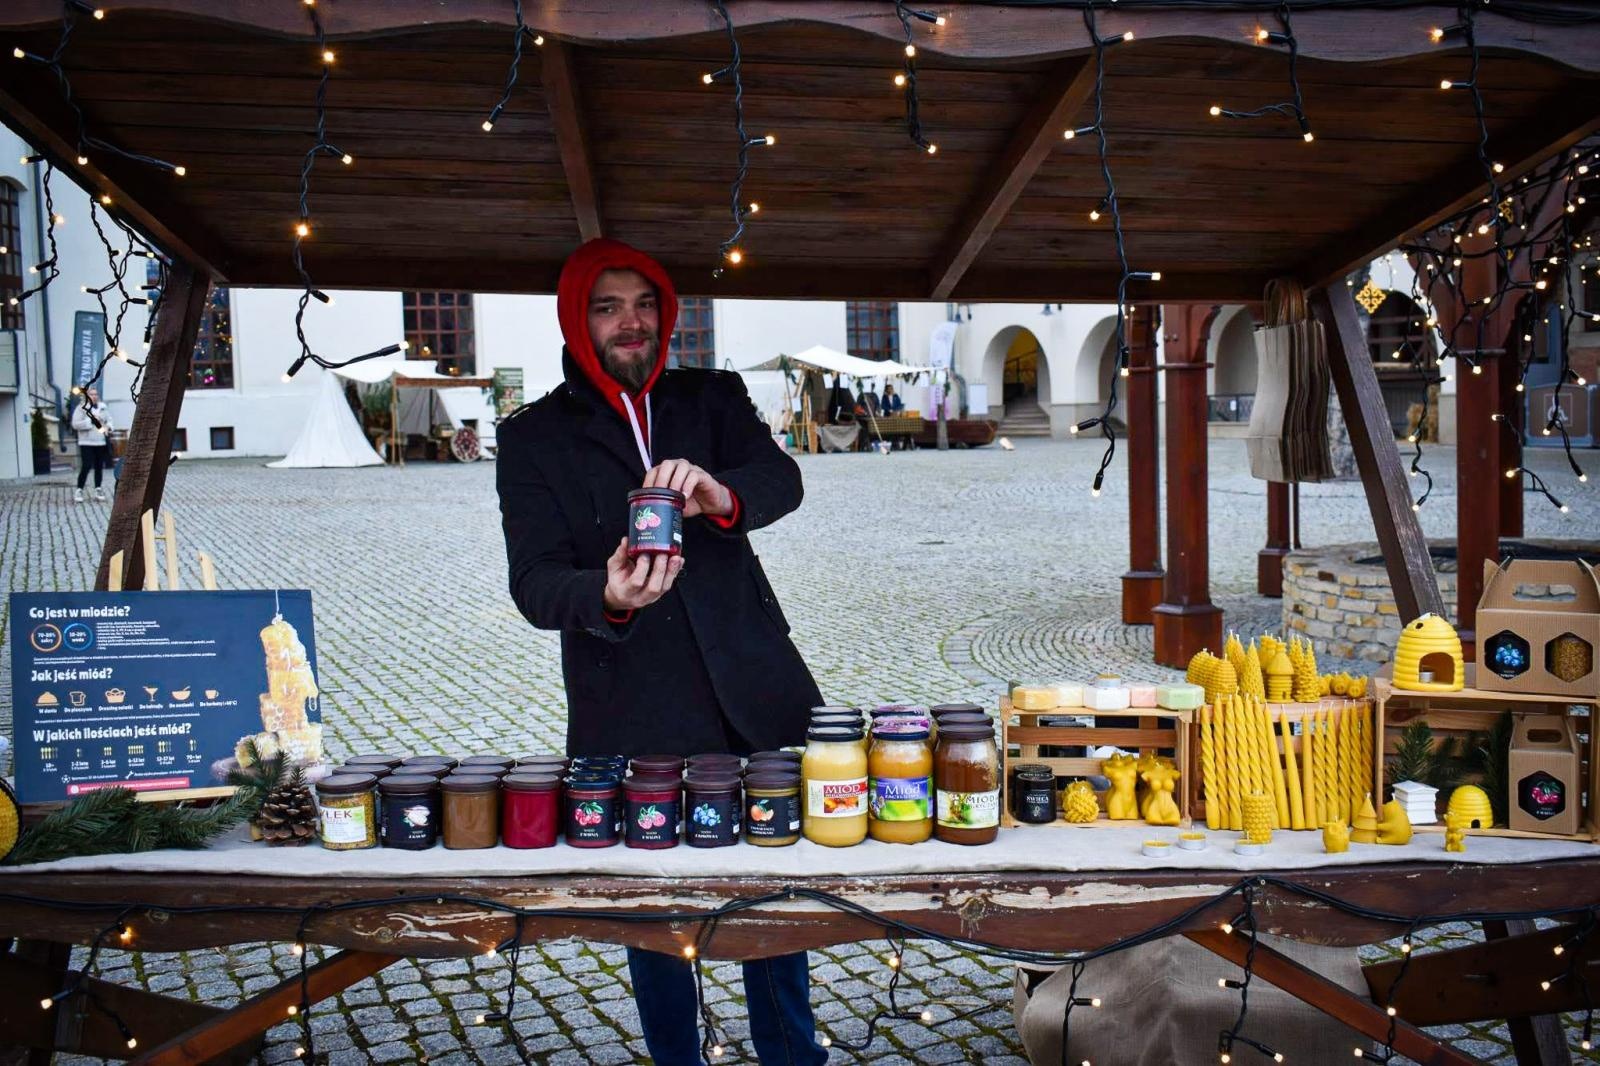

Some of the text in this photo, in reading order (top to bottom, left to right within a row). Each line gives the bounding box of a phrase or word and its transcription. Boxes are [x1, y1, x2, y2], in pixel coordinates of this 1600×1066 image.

[80, 330, 92, 388] ZYNOWNIA
[30, 606, 131, 620] Co jest w miodzie?
[31, 668, 113, 683] Jak jeść miód?
[33, 723, 192, 743] W jakich ilościach jeść miód?
